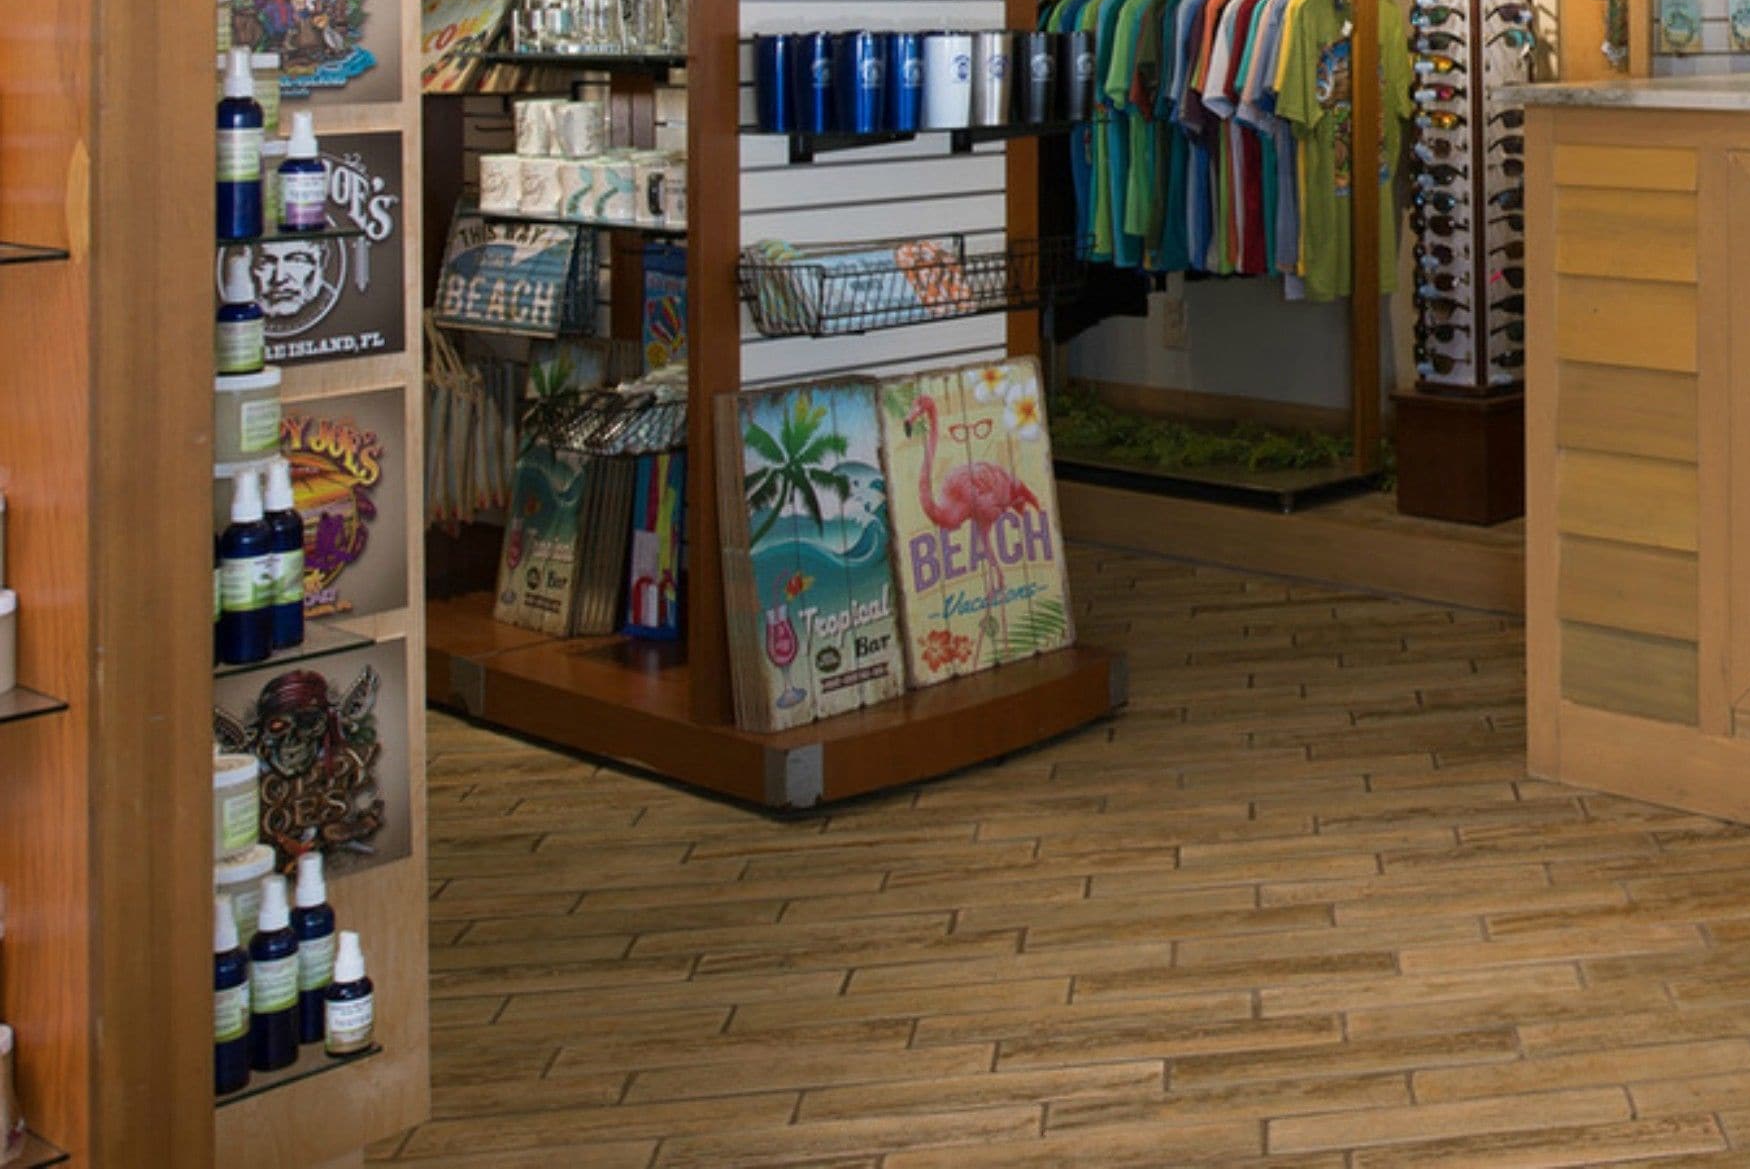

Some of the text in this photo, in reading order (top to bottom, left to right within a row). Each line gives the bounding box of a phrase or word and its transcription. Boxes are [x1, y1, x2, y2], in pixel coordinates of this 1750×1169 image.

[445, 272, 555, 327] BEACH
[908, 509, 1054, 593] BEACH
[855, 635, 891, 658] Bar
